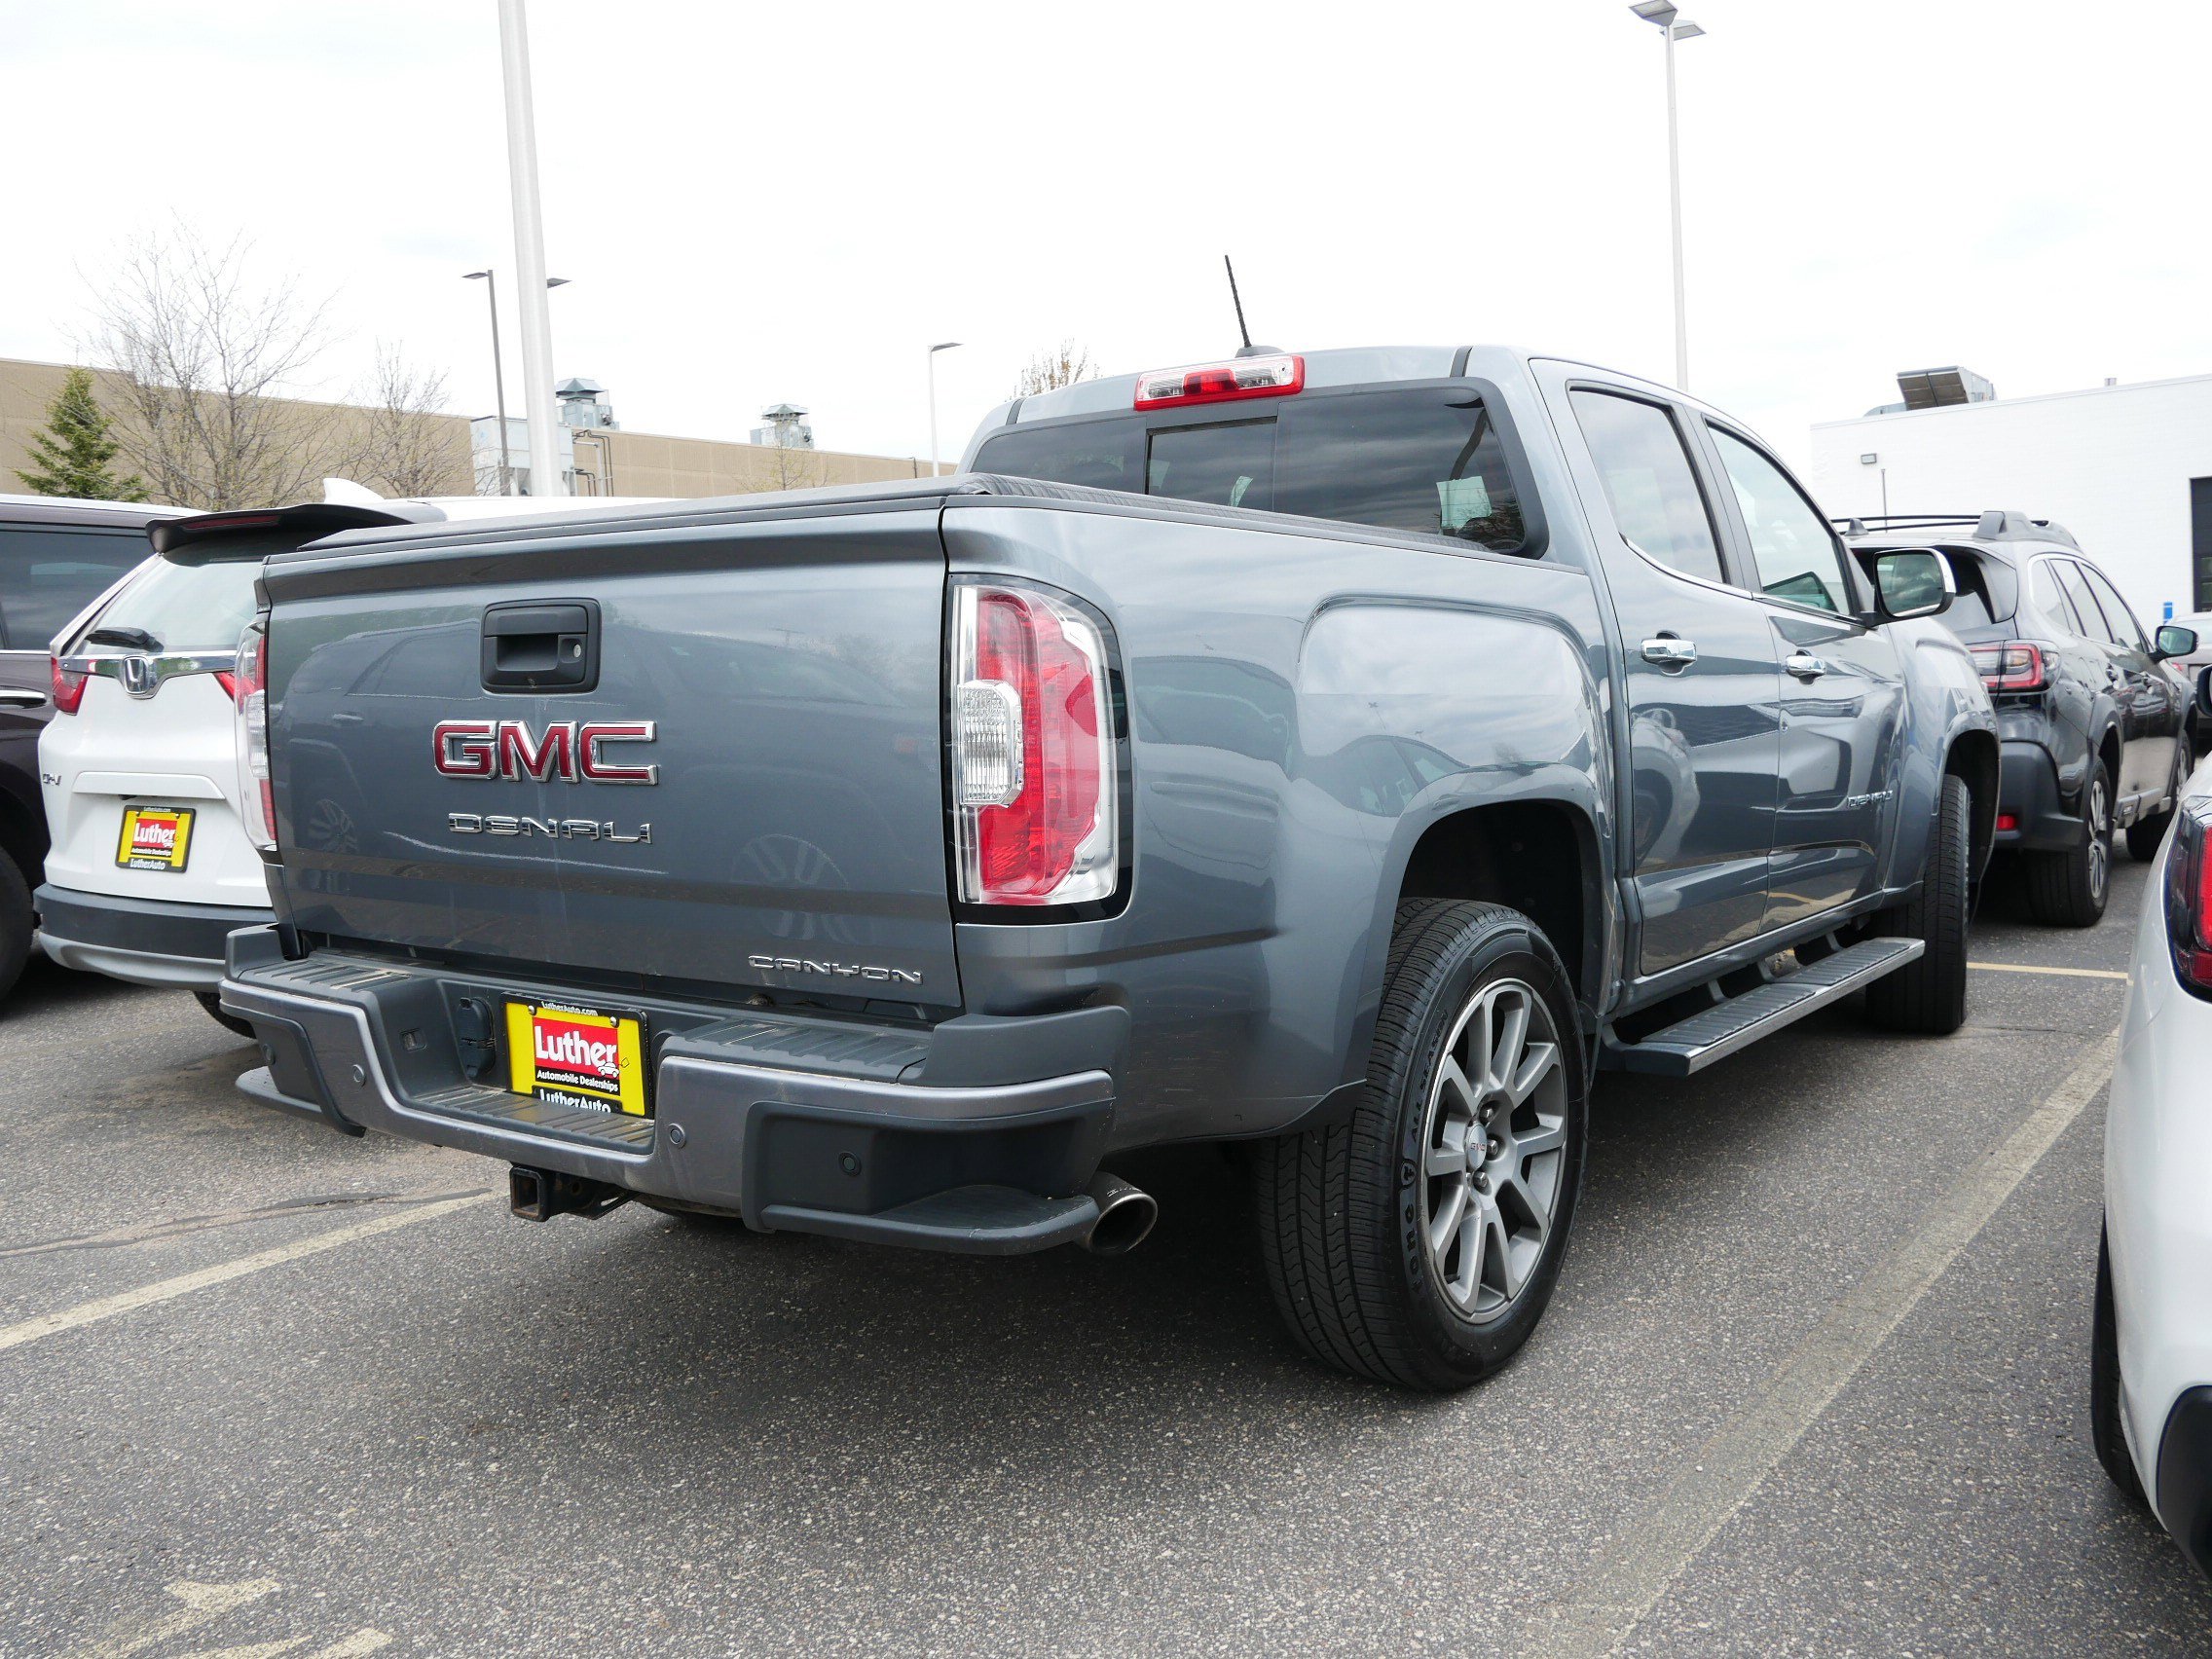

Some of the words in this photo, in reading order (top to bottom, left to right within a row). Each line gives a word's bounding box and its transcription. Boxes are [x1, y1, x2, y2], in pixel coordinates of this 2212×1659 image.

[432, 720, 658, 785] GMC
[134, 822, 176, 844] Luther
[448, 813, 651, 844] DENALI
[129, 858, 166, 869] LutherAuto
[748, 955, 923, 985] CANYON
[541, 1000, 599, 1016] LutherAuto.com
[535, 1025, 617, 1068] Luther
[536, 1069, 578, 1085] Automobile
[579, 1075, 619, 1092] Dealerships
[539, 1088, 611, 1114] LutherAuto
